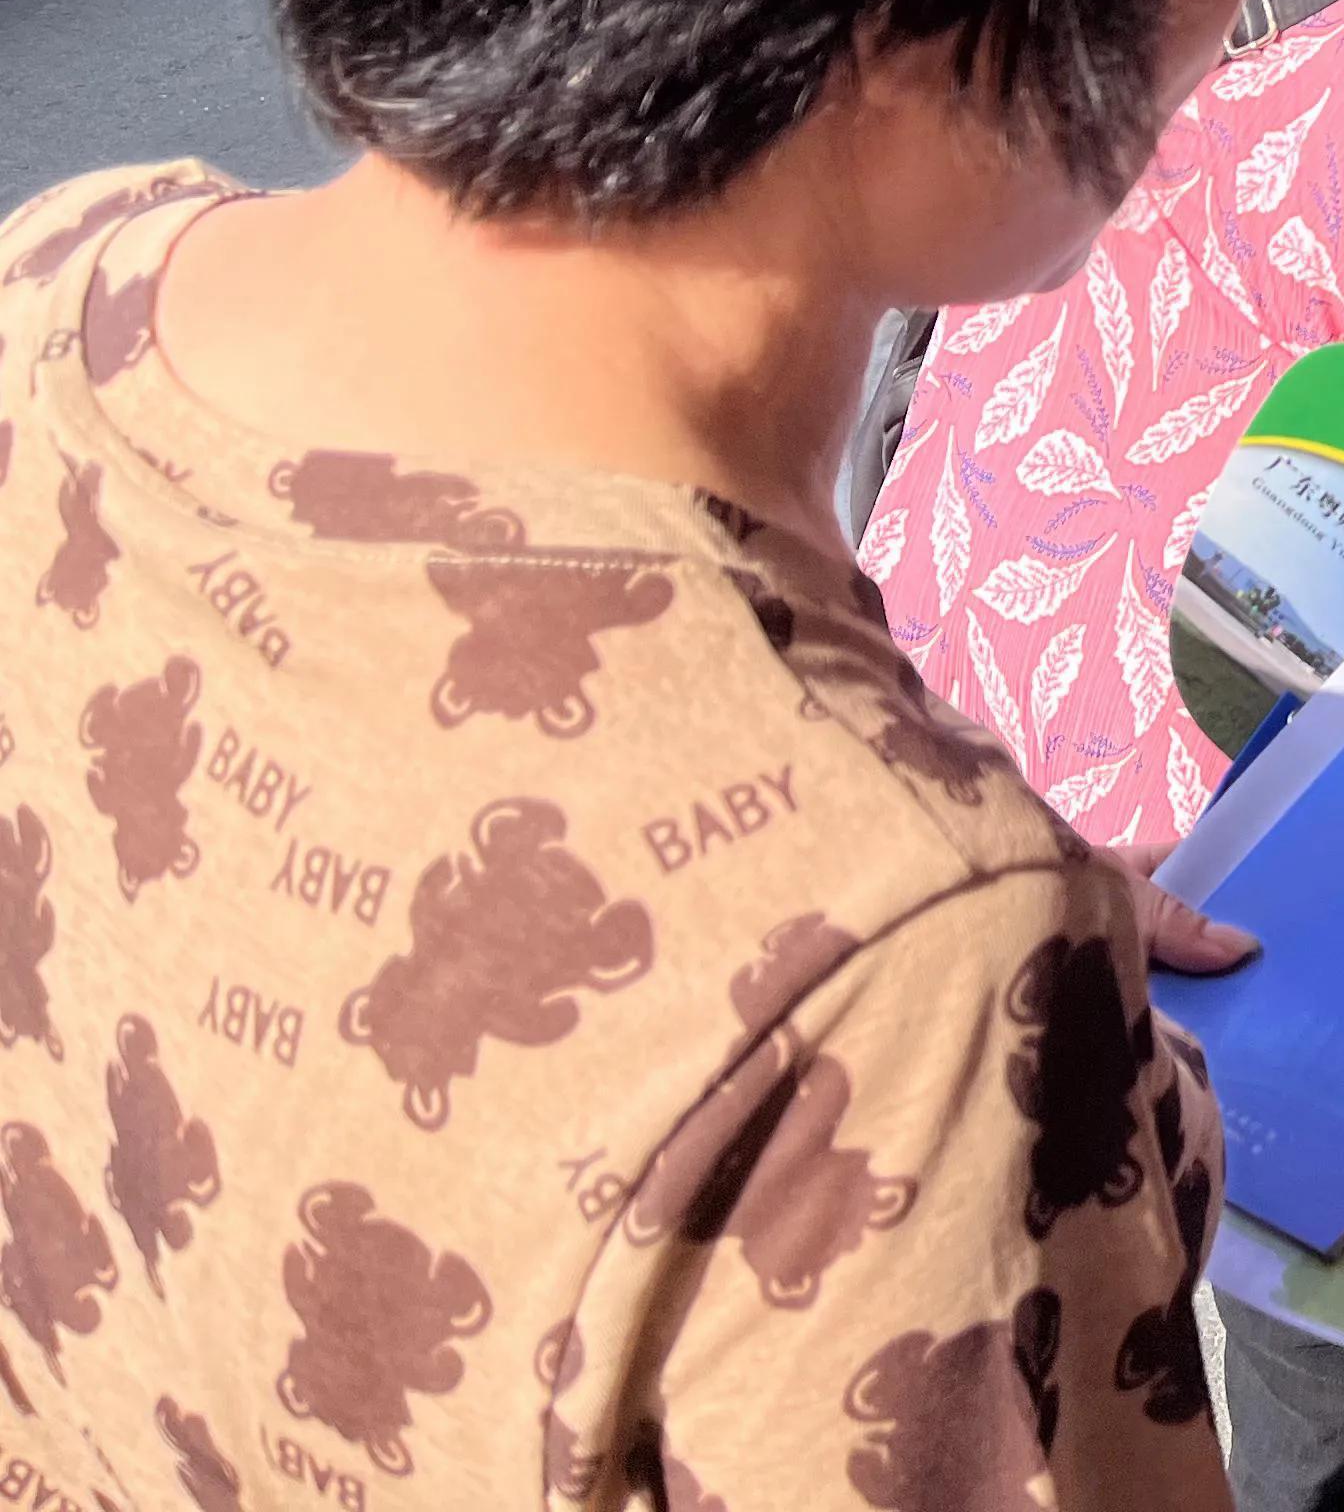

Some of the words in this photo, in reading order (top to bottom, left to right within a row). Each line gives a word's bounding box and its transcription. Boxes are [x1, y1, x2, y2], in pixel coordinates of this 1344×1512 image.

[187, 550, 290, 670] BABY
[206, 727, 312, 832] BABY
[641, 763, 801, 876] BABY
[270, 838, 392, 927] BABY
[198, 976, 303, 1068] BABY
